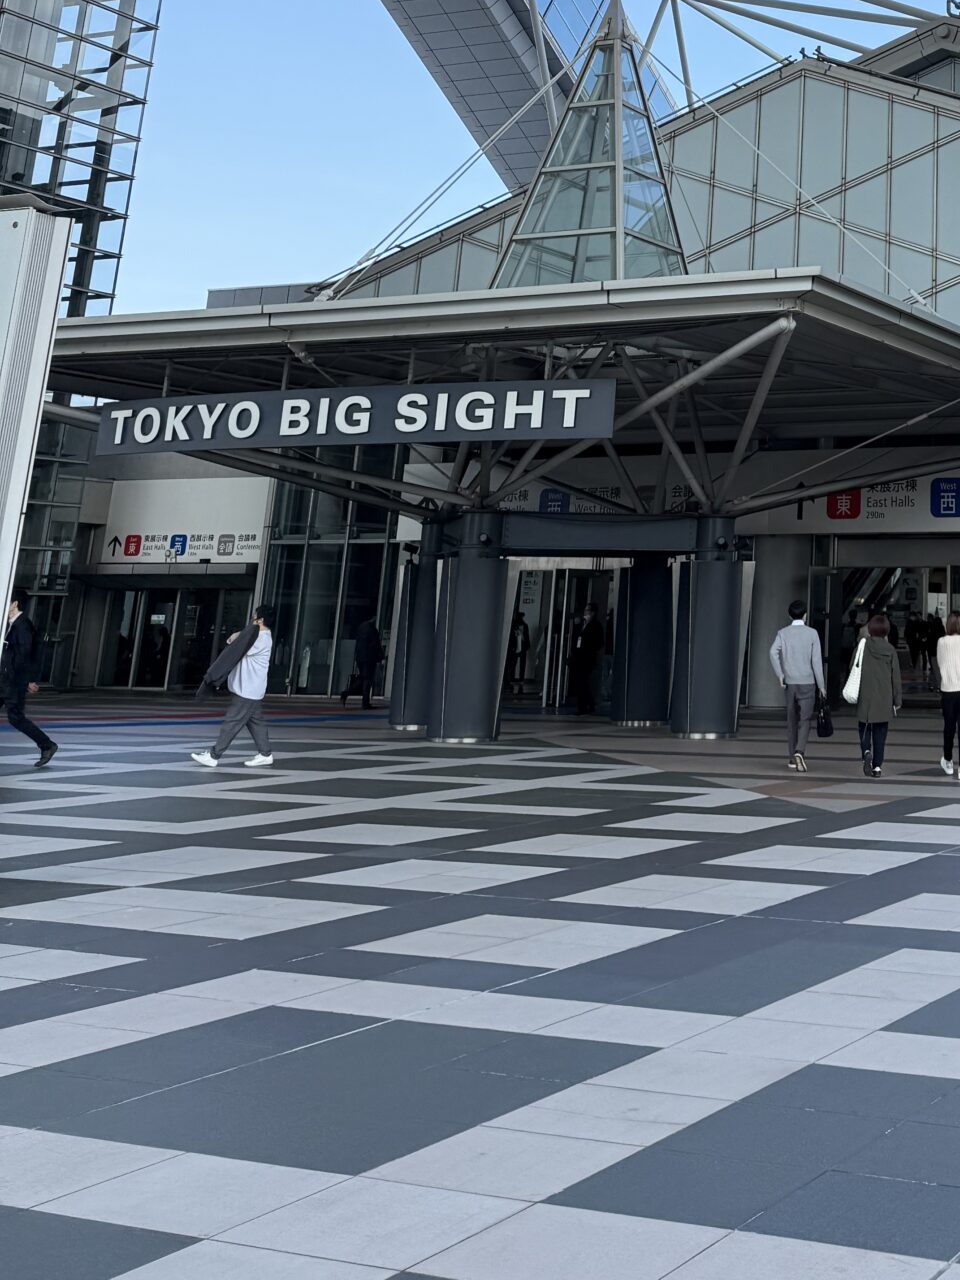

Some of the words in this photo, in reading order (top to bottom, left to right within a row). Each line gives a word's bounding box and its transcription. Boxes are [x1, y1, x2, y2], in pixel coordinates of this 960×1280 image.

[110, 401, 261, 445] TOKYO
[279, 395, 372, 436] BIG
[395, 389, 592, 431] SIGHT
[939, 482, 958, 490] West
[836, 495, 852, 515] 東
[866, 496, 888, 508] East
[891, 495, 915, 508] Halls
[940, 493, 956, 514] 西
[866, 510, 885, 519] 290m
[127, 543, 136, 554] 東
[142, 543, 153, 551] East
[154, 543, 166, 551] Halls
